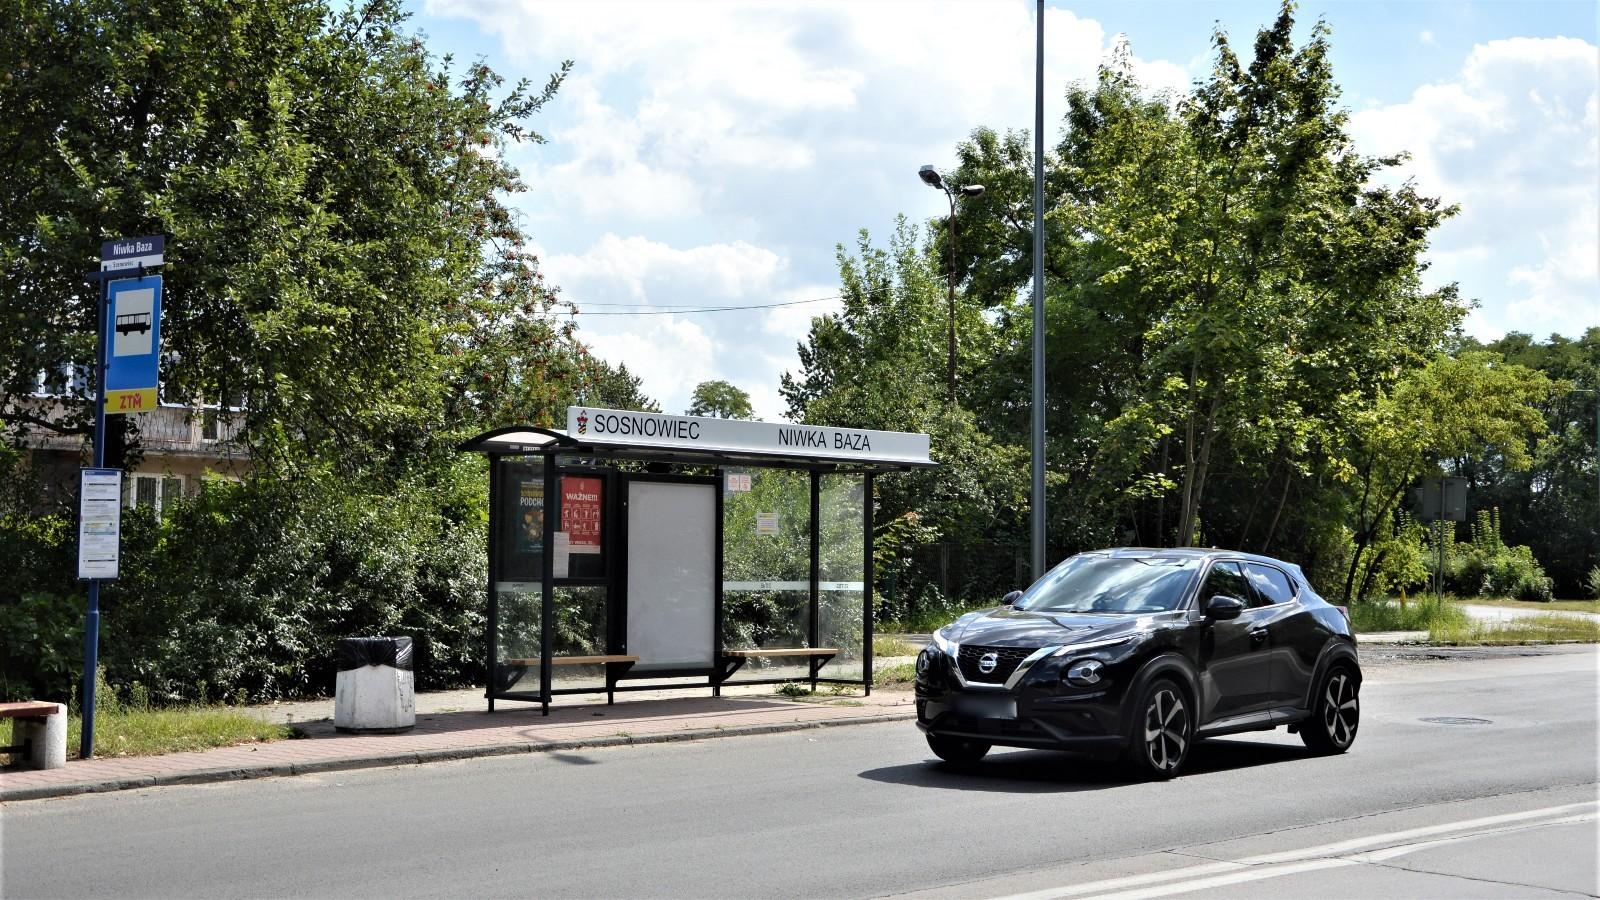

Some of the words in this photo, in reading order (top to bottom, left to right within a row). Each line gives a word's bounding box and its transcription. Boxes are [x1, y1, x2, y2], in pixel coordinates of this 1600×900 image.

[113, 243, 135, 256] Niwka
[136, 241, 153, 253] Baza
[594, 414, 700, 440] SOSNOWIEC
[778, 428, 827, 449] NIWKA
[834, 432, 871, 452] BAZA
